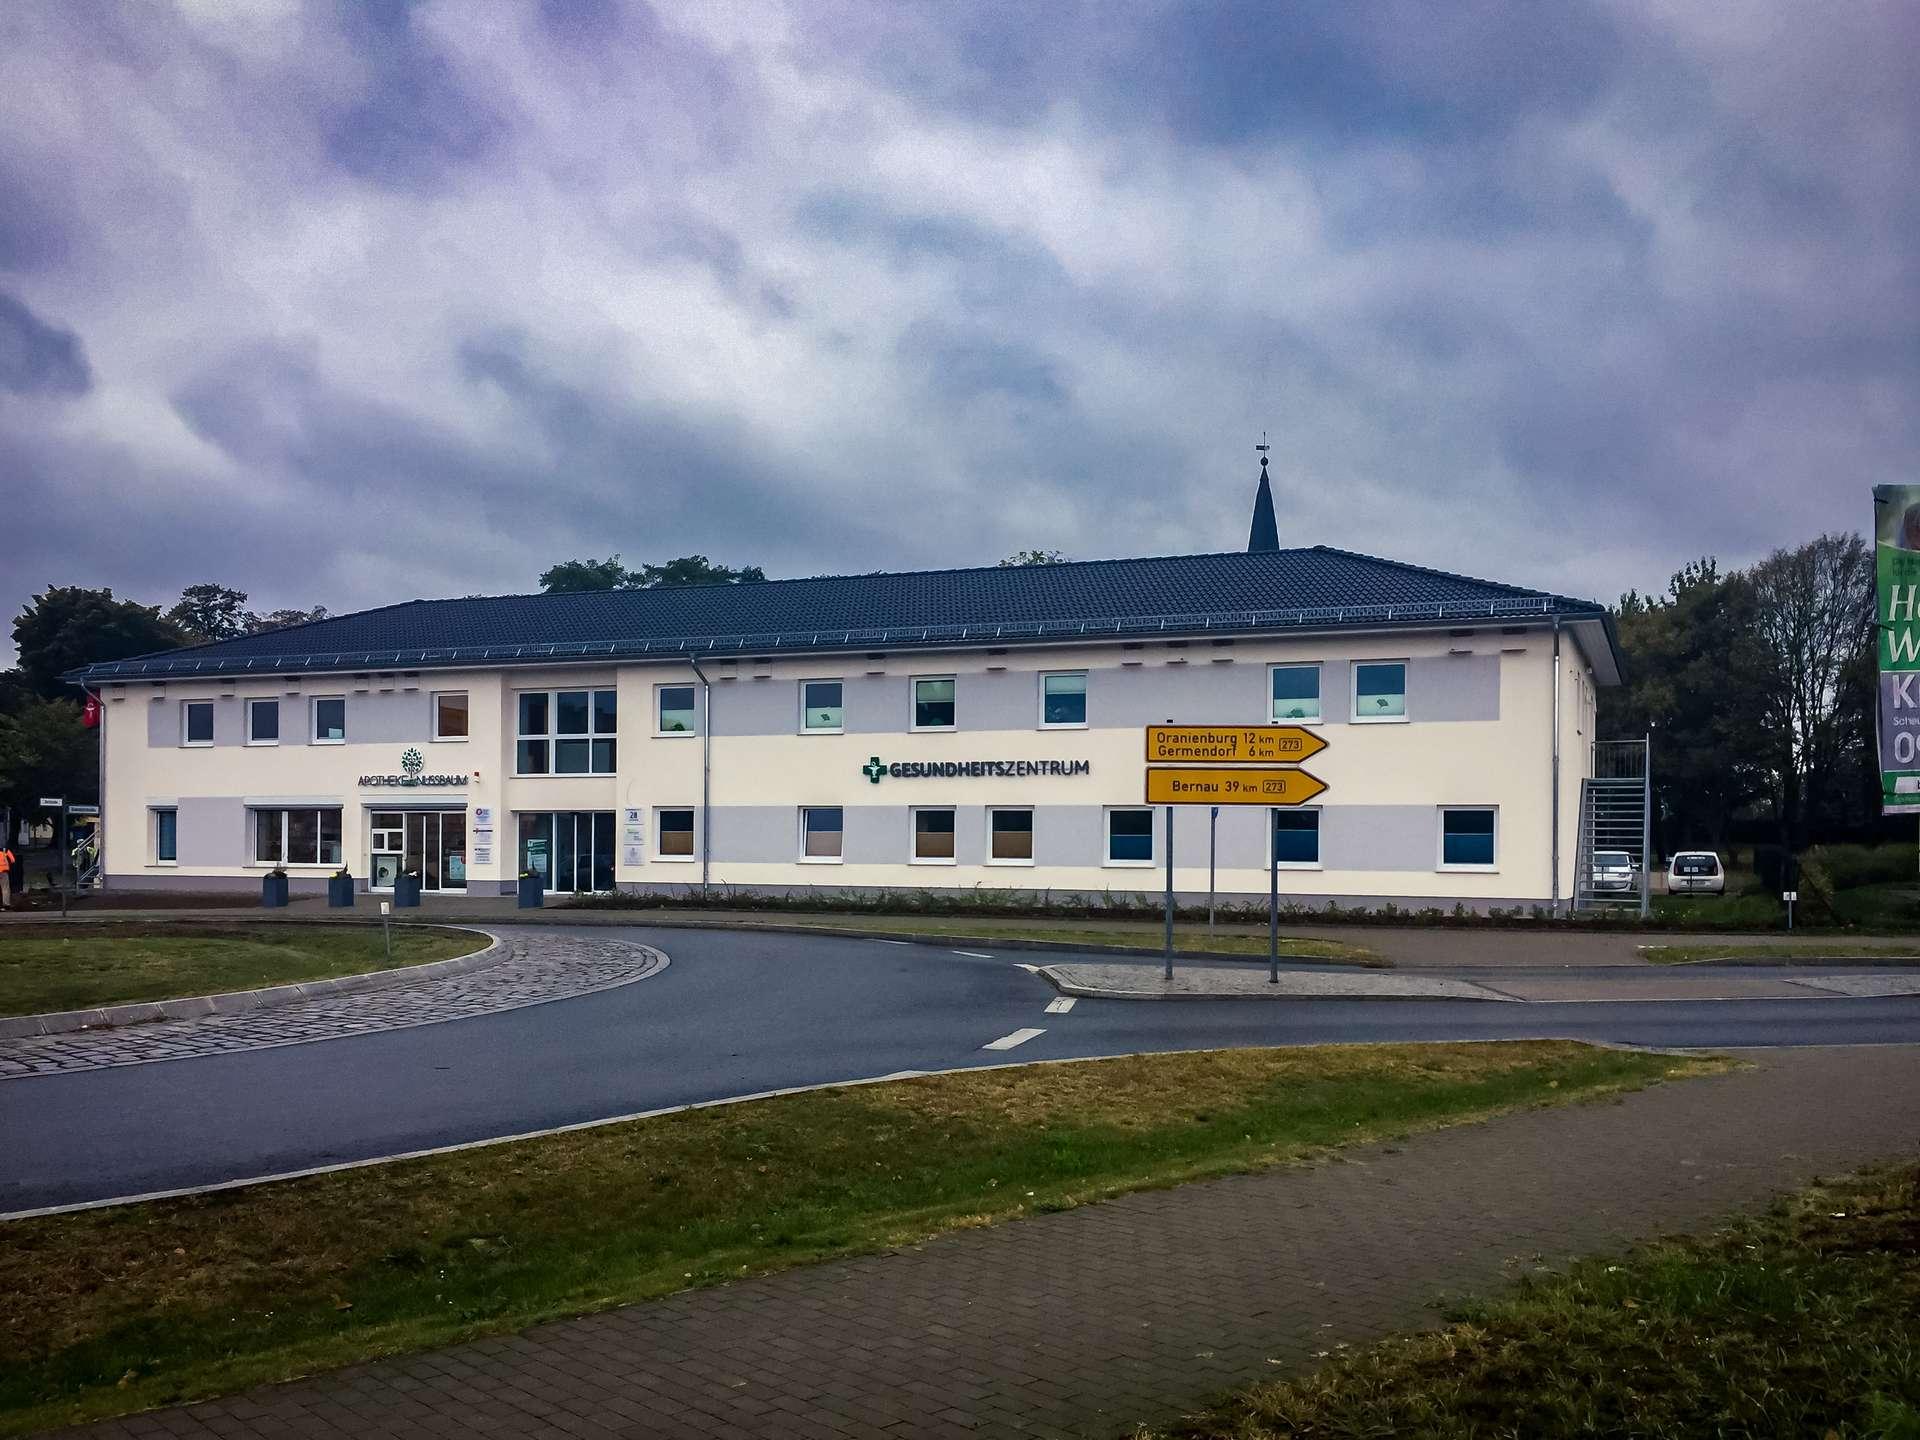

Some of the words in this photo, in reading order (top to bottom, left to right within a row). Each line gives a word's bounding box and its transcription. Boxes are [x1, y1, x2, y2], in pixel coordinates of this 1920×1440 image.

[1888, 585, 1920, 621] H
[1156, 732, 1237, 749] Oranienburg
[1243, 732, 1256, 744] 12
[1259, 735, 1274, 744] km
[1281, 740, 1299, 750] 273
[1158, 745, 1237, 757] Germendorf
[1248, 746, 1256, 757] 6
[1259, 748, 1274, 757] km
[889, 760, 1090, 777] GESUNDHEITSZENTRUM
[358, 775, 408, 786] APOTHEKE
[1172, 780, 1219, 792] Bernau
[1225, 781, 1240, 792] 39
[1243, 784, 1258, 792] km
[1265, 782, 1284, 792] 273
